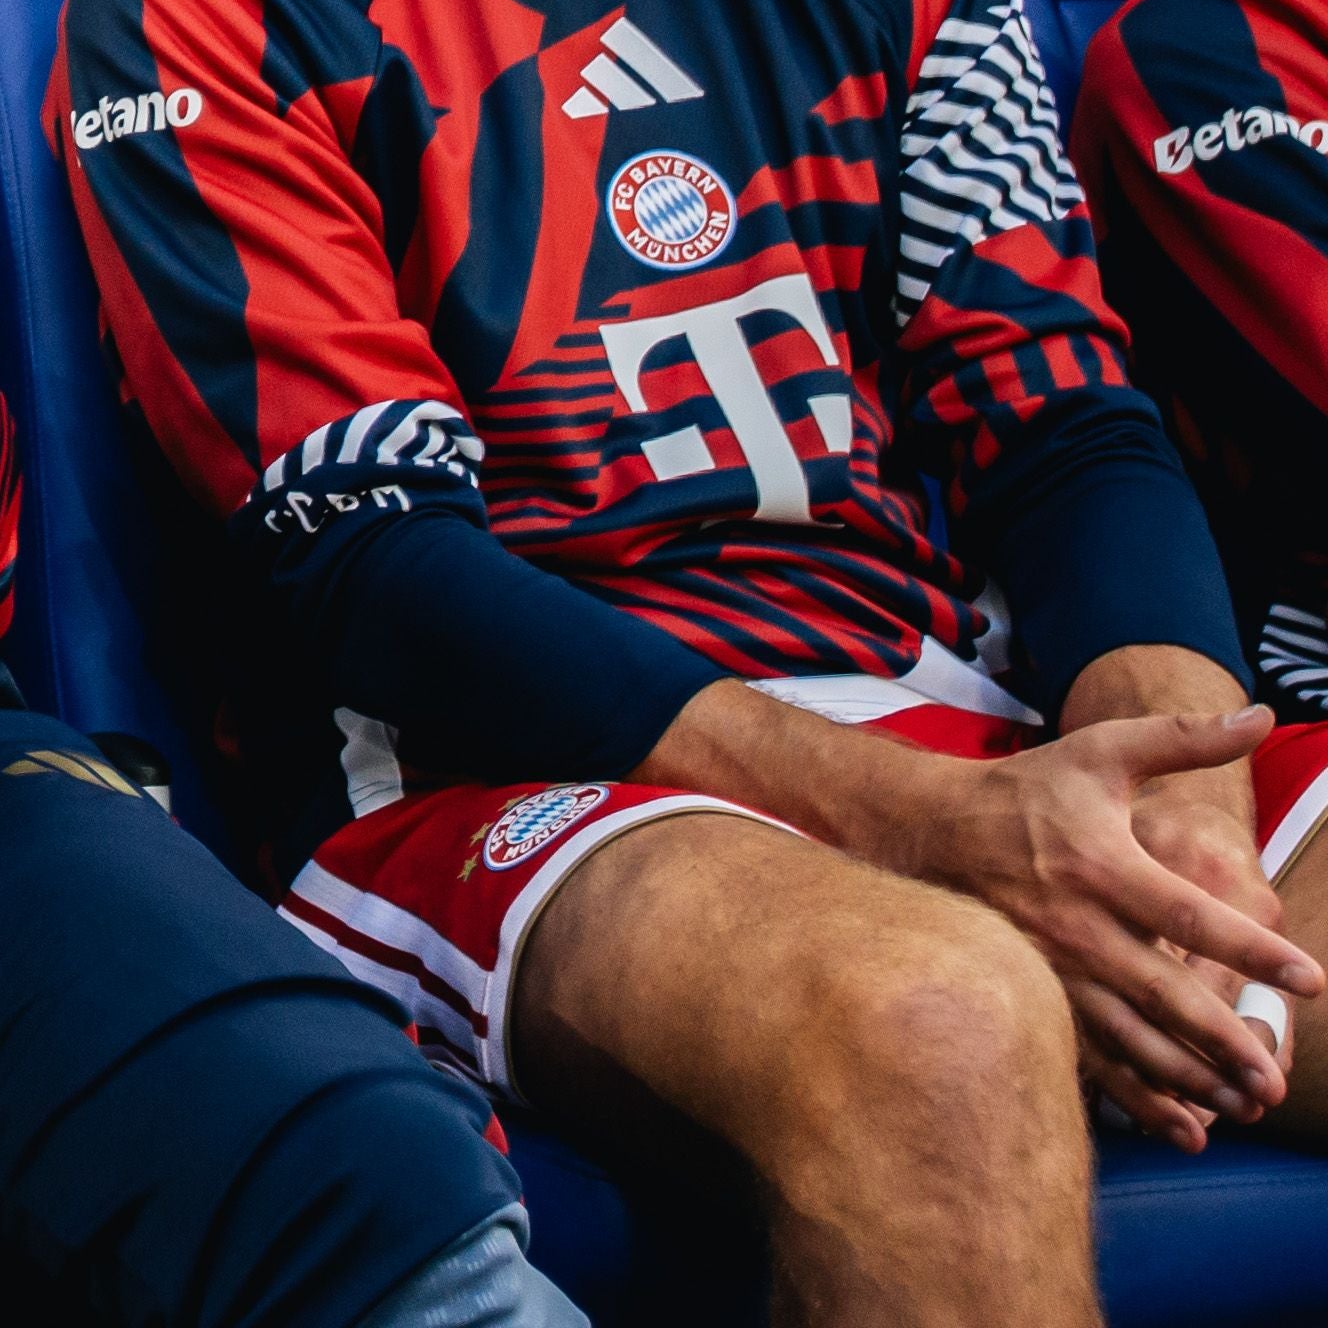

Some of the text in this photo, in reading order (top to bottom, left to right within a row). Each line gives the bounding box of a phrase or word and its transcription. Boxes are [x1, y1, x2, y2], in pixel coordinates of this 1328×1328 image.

[71, 87, 203, 150] etano
[615, 157, 717, 211] FC BAYERN
[626, 210, 729, 263] MÜNCHEN
[599, 273, 853, 529] T
